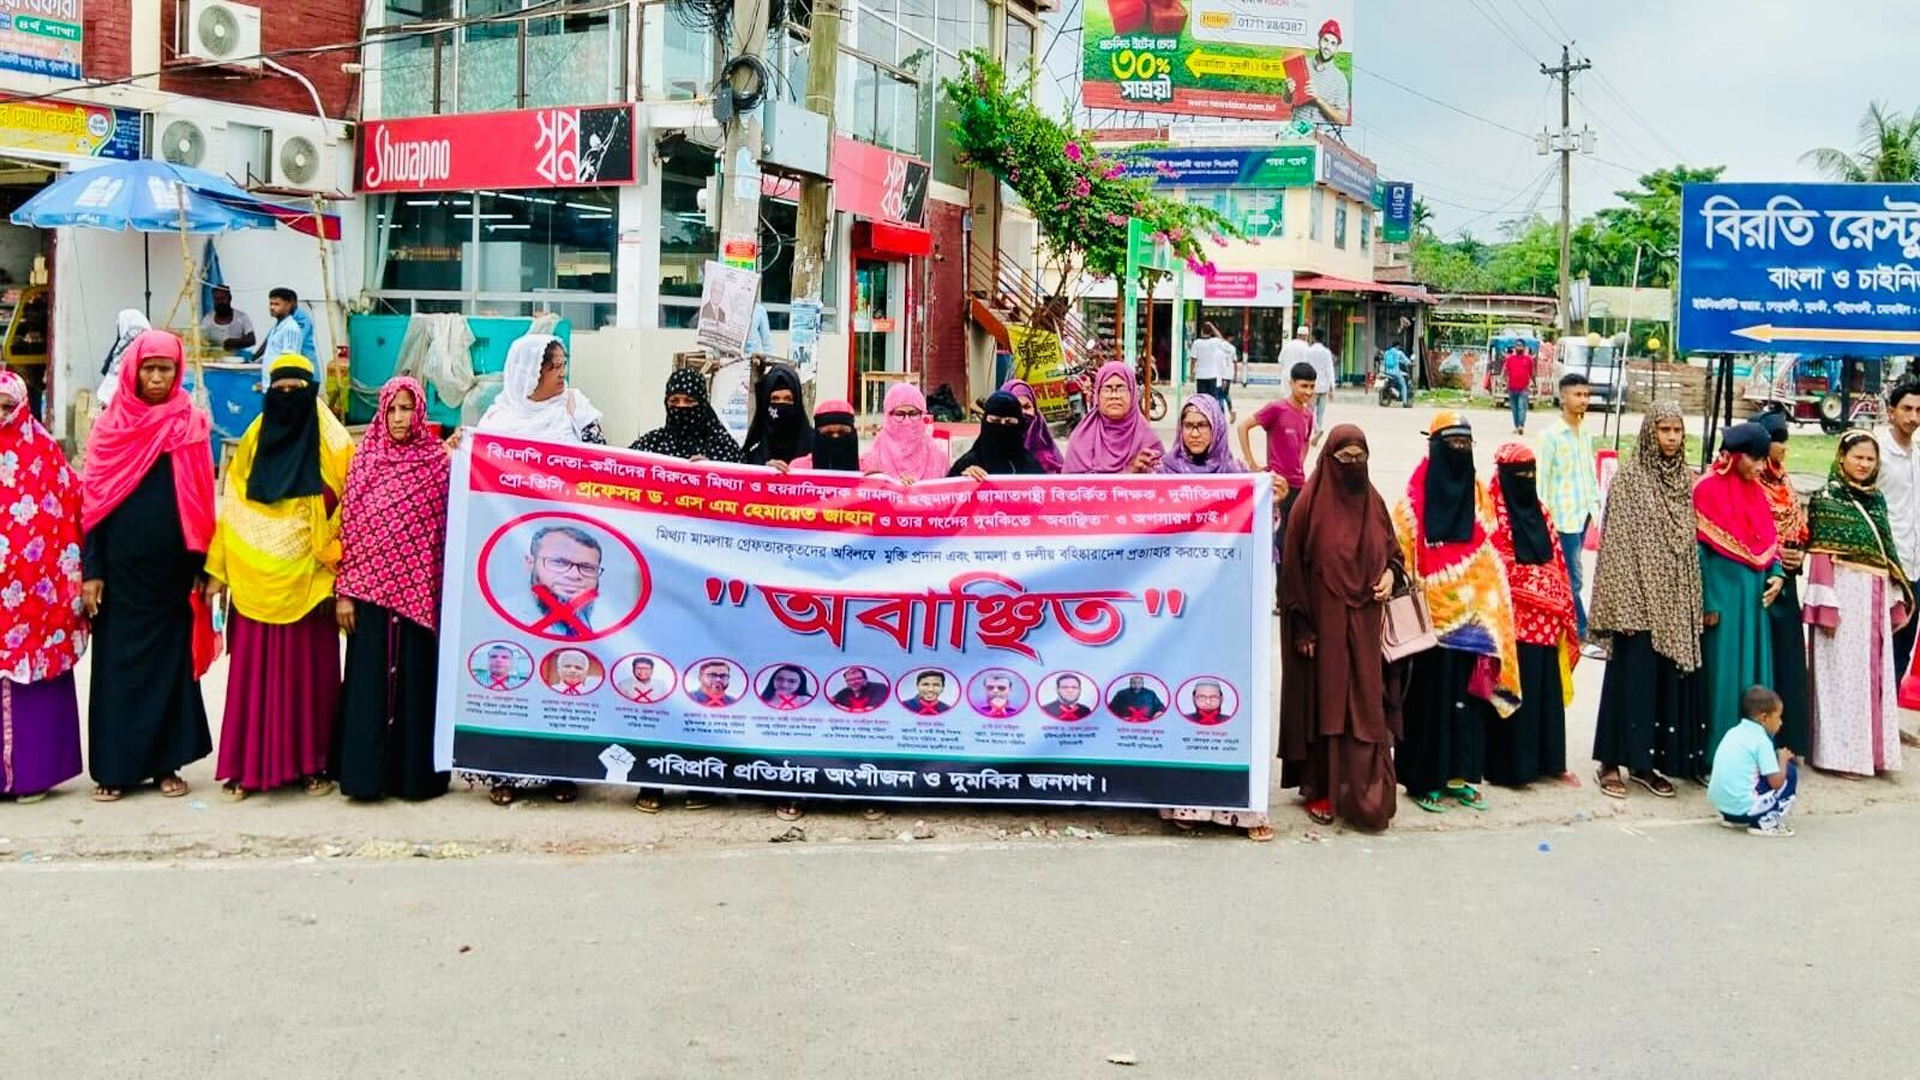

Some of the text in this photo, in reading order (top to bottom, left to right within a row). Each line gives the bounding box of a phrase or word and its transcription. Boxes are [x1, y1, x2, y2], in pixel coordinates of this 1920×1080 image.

[366, 124, 450, 188] Shwapno
[1699, 194, 1920, 259] বিরতি রেস্টু
[1767, 267, 1825, 291] বাংলা
[1832, 268, 1851, 289] ও
[487, 442, 541, 464] বিএনপি
[547, 455, 645, 478] নেতা-কর্মীদের
[652, 465, 700, 486] বিরুদ্ধে
[705, 473, 744, 490] মিথ্যা
[750, 482, 761, 492] ও
[767, 481, 851, 501] হয়রানিমূলক
[976, 486, 1046, 505] জামাতপন্থী
[1051, 486, 1107, 503] বিতর্কিত
[576, 481, 641, 502] প্রফেসর
[647, 490, 669, 506] ড.
[675, 494, 705, 511] এস
[709, 500, 739, 515] এম
[743, 503, 818, 522] হেমায়েত
[822, 508, 875, 526] জাহান
[880, 516, 892, 527] ও
[897, 515, 922, 528] তার
[928, 515, 969, 529] গংদের
[973, 511, 1031, 530] দুমকিতে
[1116, 515, 1127, 525] ও
[1132, 512, 1192, 525] অপসারণ
[656, 525, 685, 543] মিথ্যা
[691, 532, 733, 549] মামলায়
[737, 537, 827, 561] গ্রেফতারকৃতদের
[831, 544, 876, 562] অবিলম্বে
[884, 546, 907, 564] মুক্তি
[911, 549, 942, 564] প্রদান
[946, 549, 970, 563] এবং
[974, 549, 1007, 562] মামলা
[1012, 550, 1021, 561] ও
[1026, 545, 1055, 562] দলীয়
[1126, 545, 1171, 561] প্রত্যাহার
[1175, 546, 1209, 560] করতে
[647, 754, 728, 780] পবিপ্রবি
[733, 760, 818, 785] প্রতিষ্ঠার
[823, 763, 916, 788] অংশীজন
[923, 772, 941, 788] ও
[948, 769, 1022, 793] দুমকির
